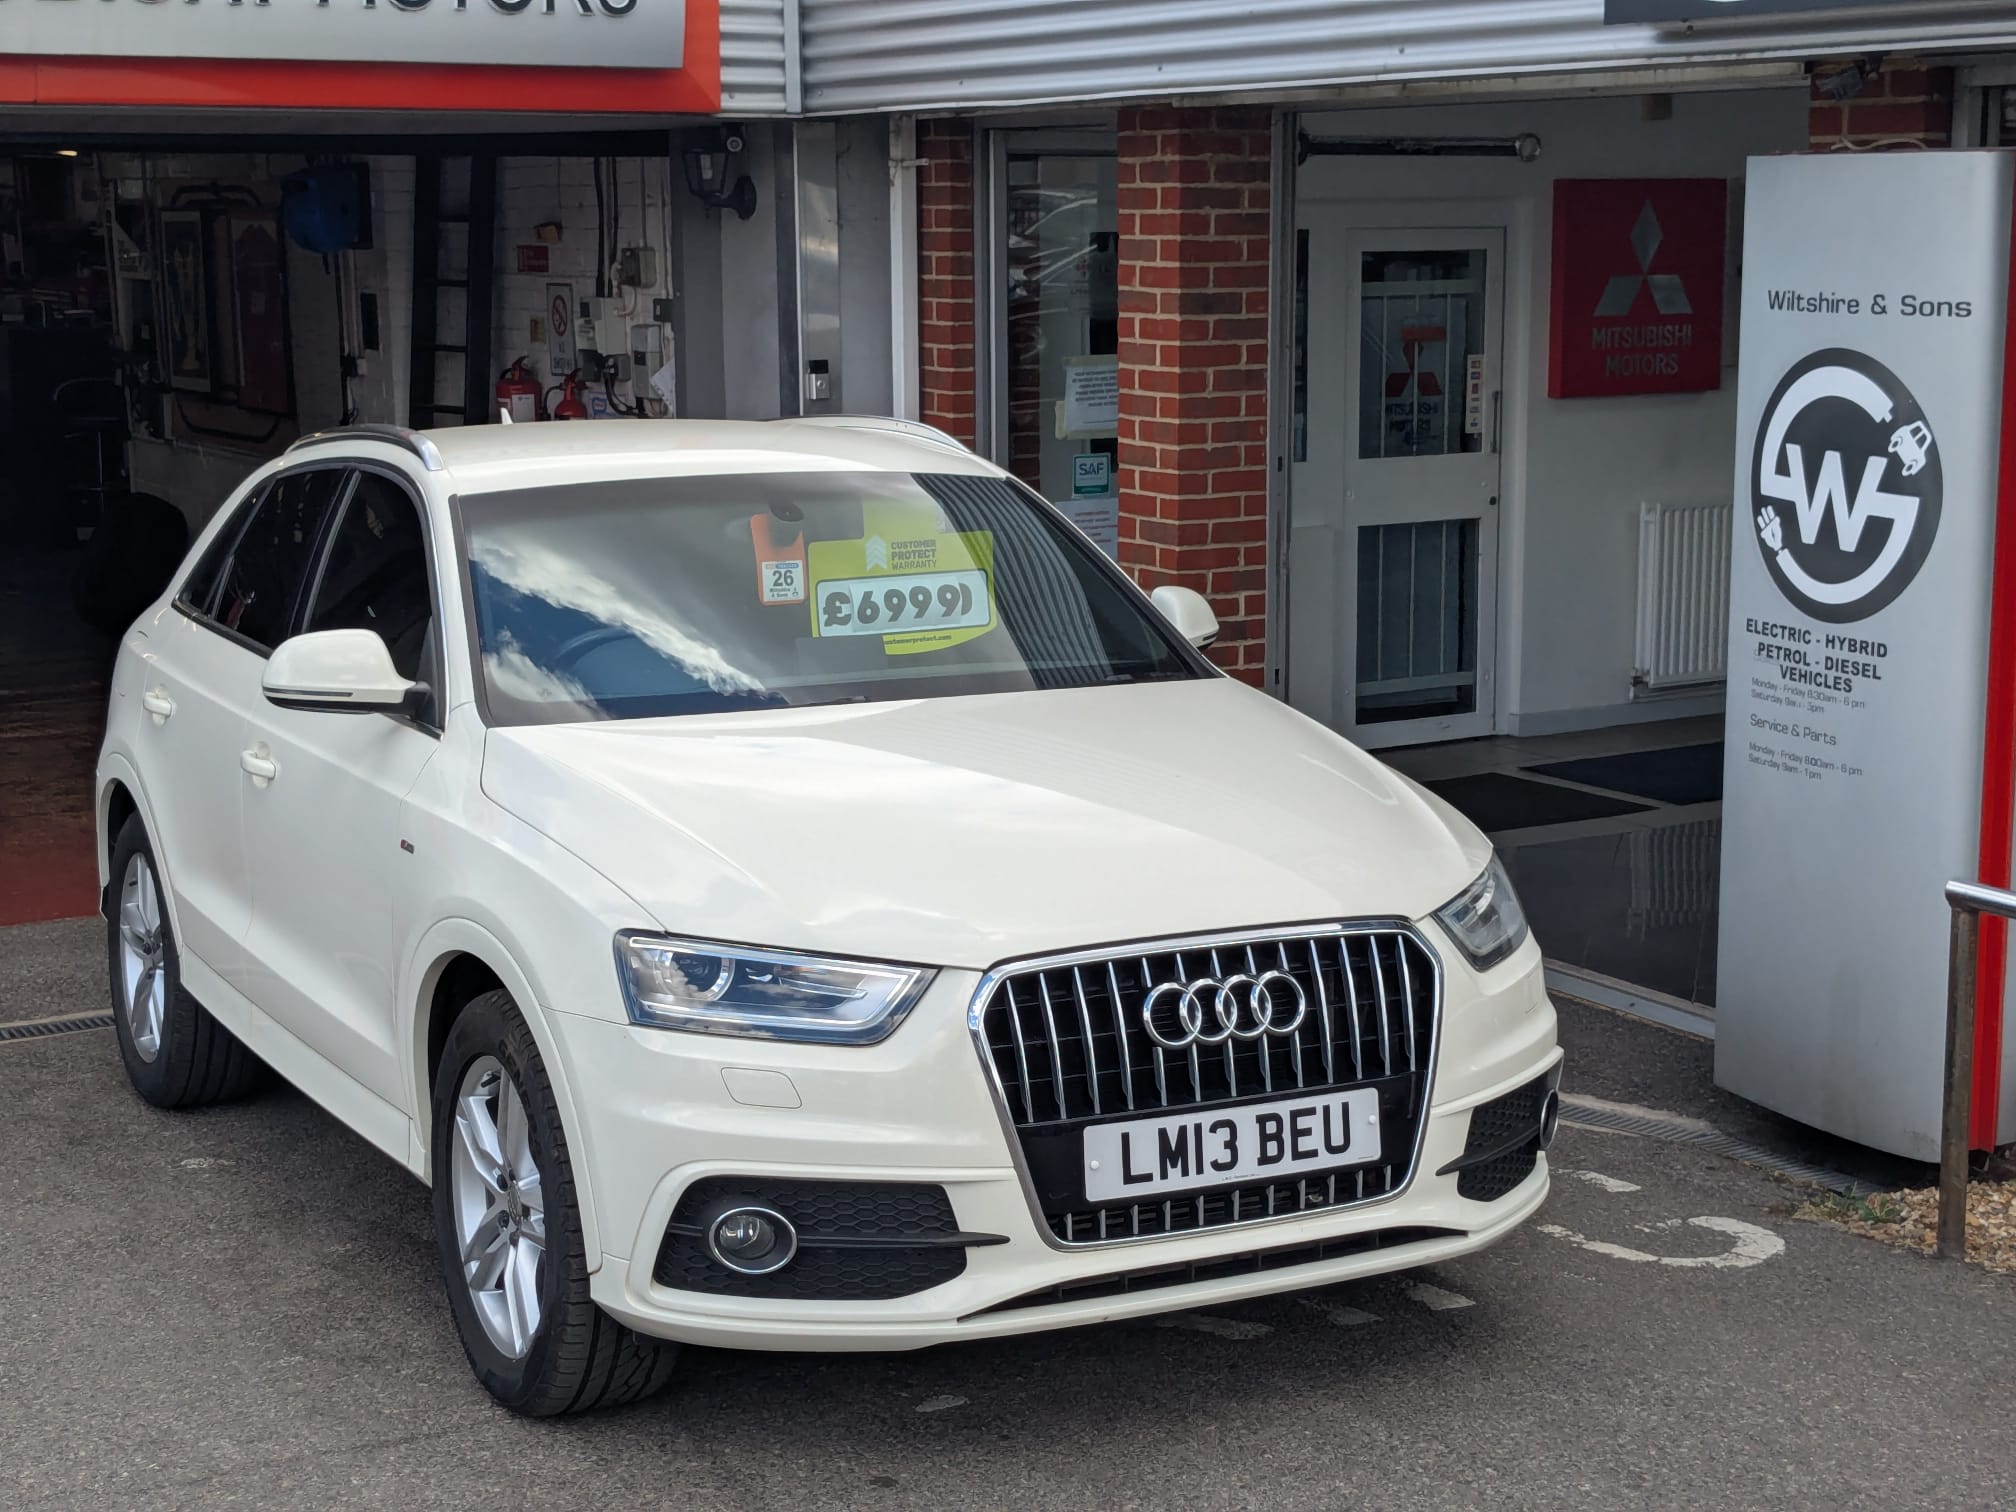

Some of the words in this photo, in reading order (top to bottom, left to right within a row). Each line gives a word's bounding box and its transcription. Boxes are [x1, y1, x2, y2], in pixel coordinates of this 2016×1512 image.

[1768, 289, 1860, 315] Wiltshire
[1871, 294, 1888, 315] &
[1901, 295, 1973, 318] Sons
[1592, 324, 1692, 351] MITSUBISHI
[1606, 352, 1679, 376] MOTORS
[1079, 462, 1105, 477] SAF
[891, 540, 937, 551] CUSTOMER
[891, 550, 937, 561] PROTECT
[892, 560, 937, 571] WARRANTY
[772, 569, 794, 587] 26
[1746, 618, 1812, 645] ELECTRIC
[1825, 633, 1888, 658] HYBRID
[1757, 642, 1811, 667] PETROL
[1824, 656, 1882, 681] DIESEL
[1751, 677, 1778, 692] Monday
[1783, 684, 1806, 699] Friday
[1780, 664, 1853, 693] VEHICLES
[1751, 688, 1783, 707] Saturday
[1750, 713, 1789, 735] Service
[1791, 723, 1800, 737] &
[1803, 726, 1837, 746] Parts
[1748, 741, 1775, 758] Monday
[1780, 750, 1802, 765] Friday
[1748, 752, 1780, 771] Saturday
[1121, 1118, 1238, 1185] LM13
[1255, 1101, 1350, 1166] BEU
